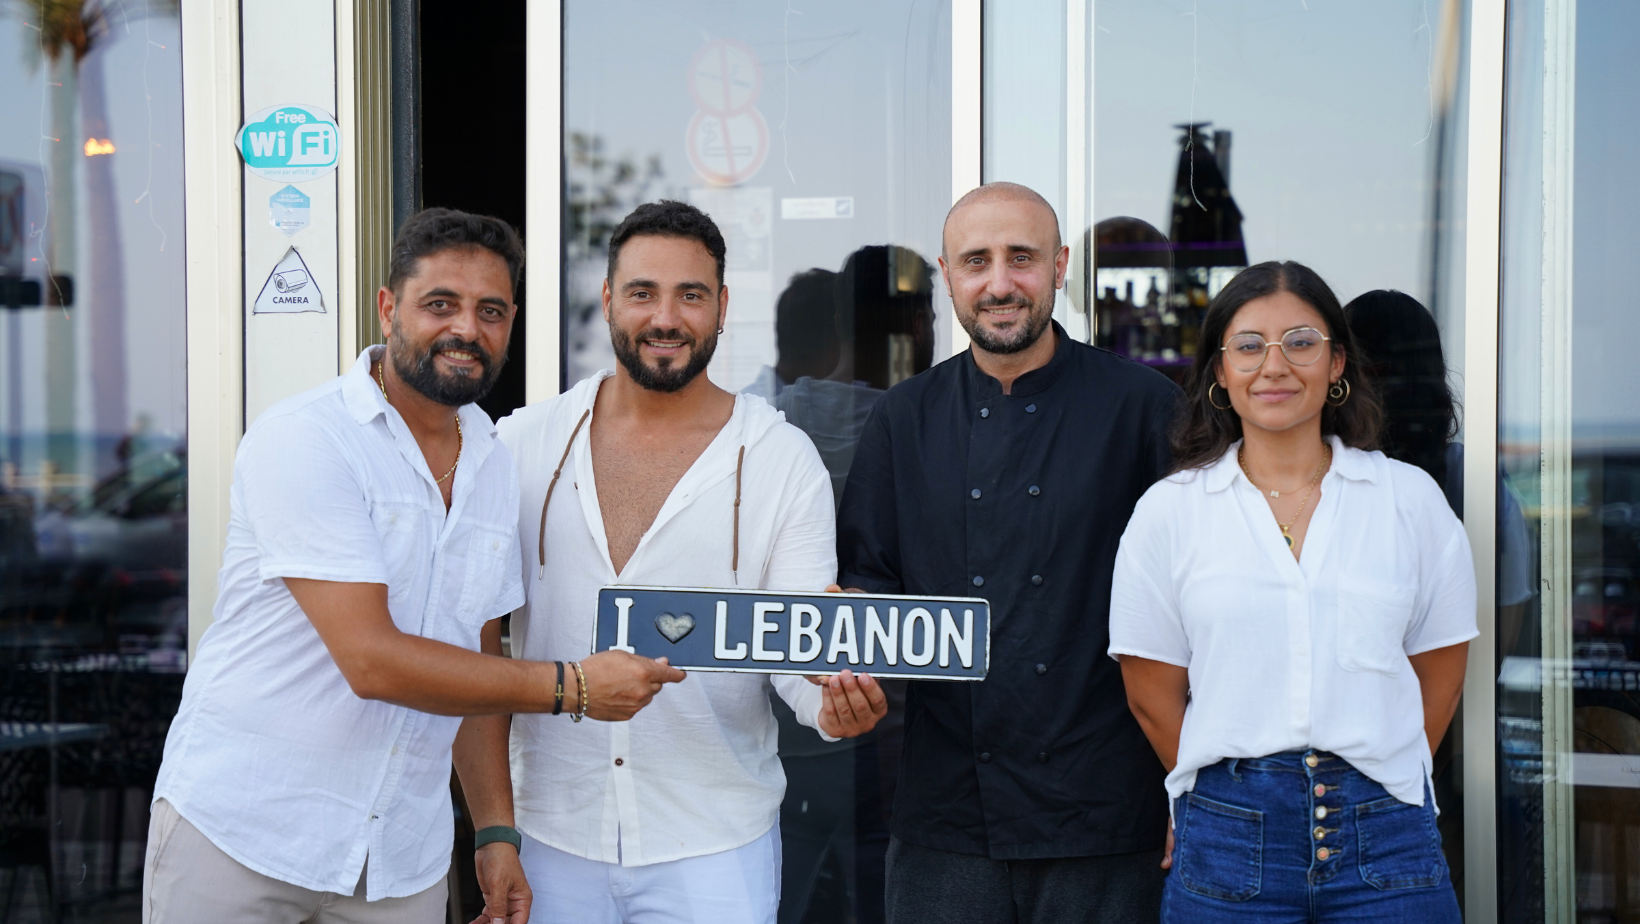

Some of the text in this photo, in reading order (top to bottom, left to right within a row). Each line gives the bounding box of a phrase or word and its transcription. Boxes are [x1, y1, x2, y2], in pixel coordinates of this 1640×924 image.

[275, 111, 307, 124] Free
[249, 130, 330, 157] Wi Fi
[272, 296, 309, 304] CAMERA
[609, 597, 975, 669] I LEBANON
